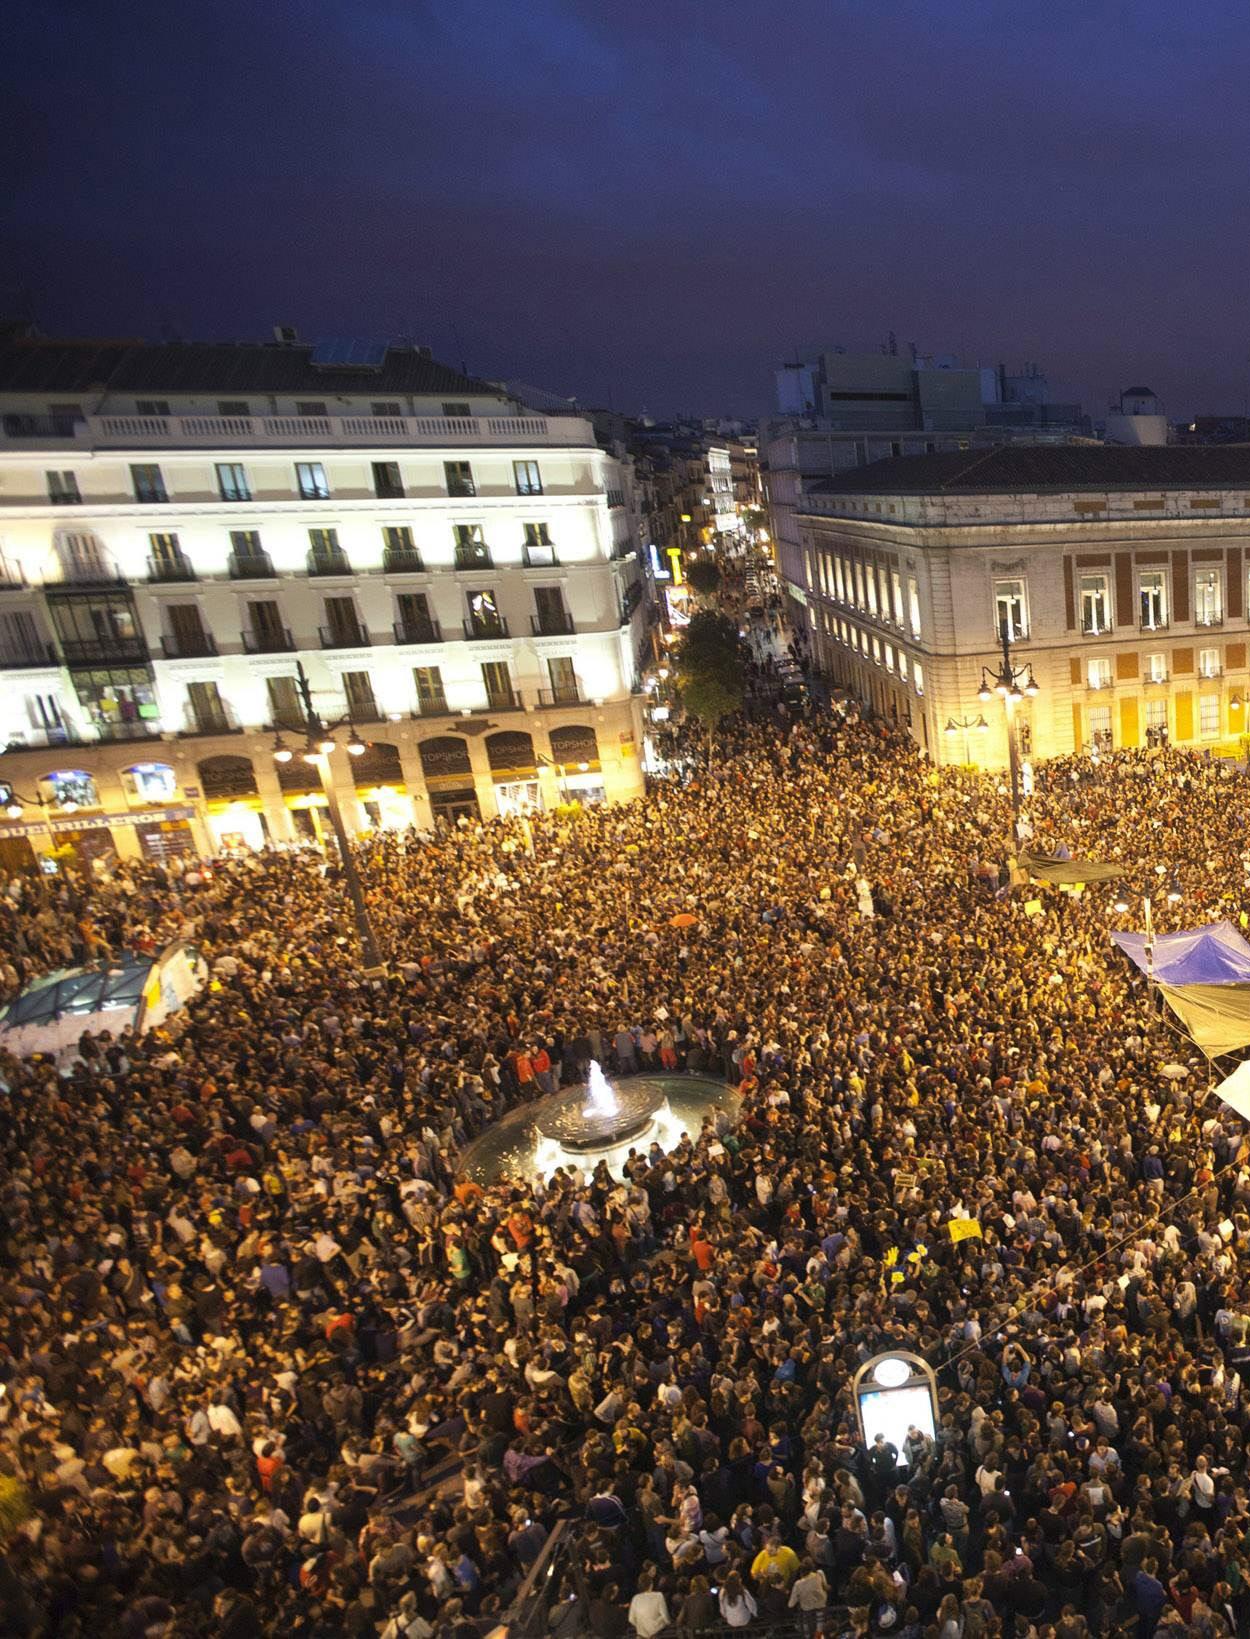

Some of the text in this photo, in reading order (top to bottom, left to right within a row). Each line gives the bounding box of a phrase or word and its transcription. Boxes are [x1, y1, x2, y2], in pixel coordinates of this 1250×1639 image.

[489, 743, 532, 755] TOPSHOP
[552, 739, 596, 751] TOPSHOP
[422, 750, 468, 763] TOPSHOP
